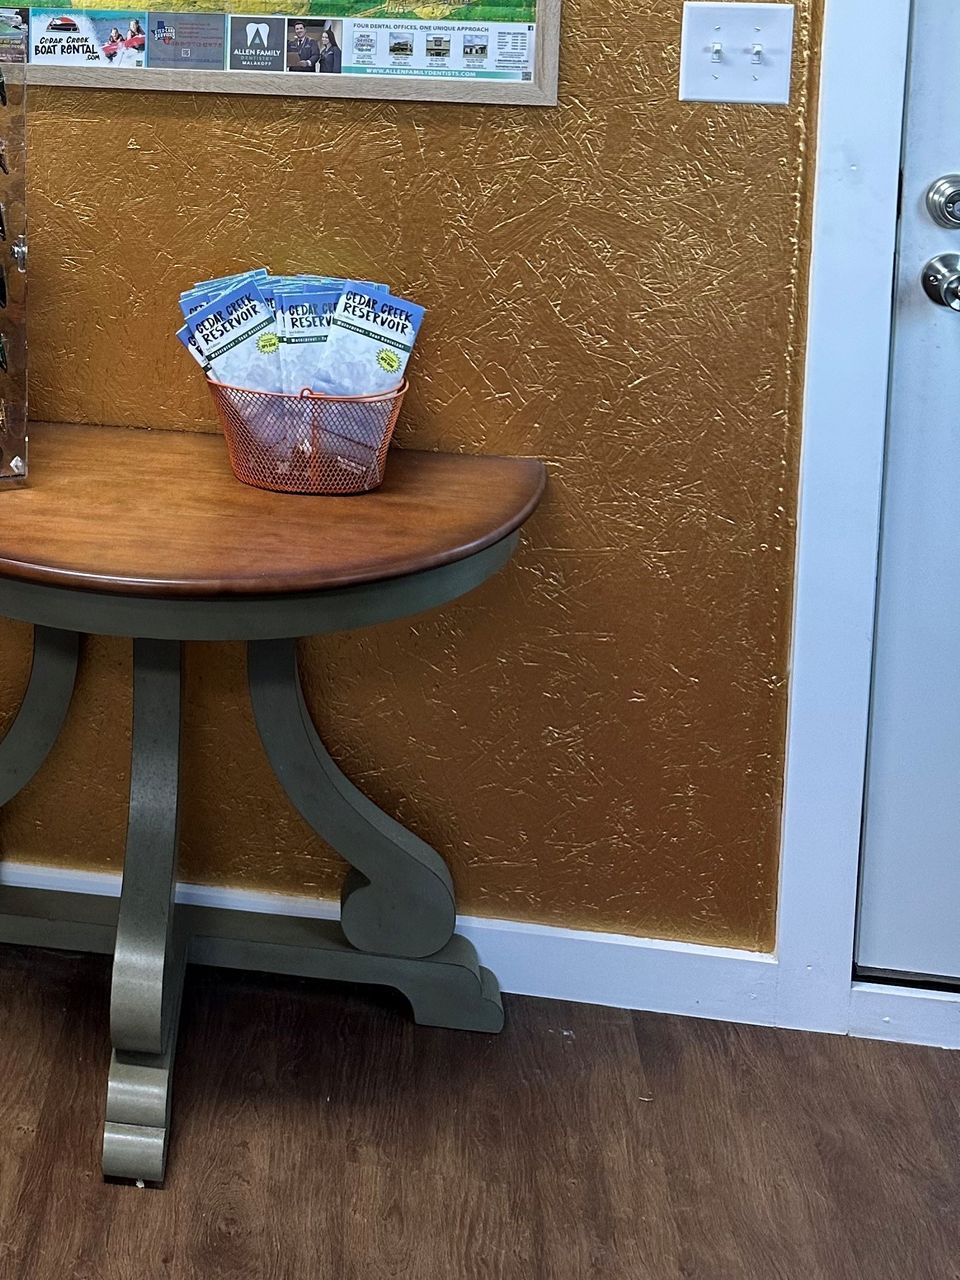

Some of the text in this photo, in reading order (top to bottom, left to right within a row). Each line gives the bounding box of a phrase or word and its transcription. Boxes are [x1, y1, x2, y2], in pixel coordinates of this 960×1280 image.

[34, 44, 58, 55] BOAT
[195, 310, 225, 334] CEDAR
[225, 293, 255, 316] CREEK
[288, 301, 338, 316] CEDAR CRE
[290, 315, 332, 329] RESERV
[343, 302, 409, 336] RESERVOIR
[345, 290, 413, 323] CEDAR CREEK
[202, 304, 260, 345] RESERVOIR
